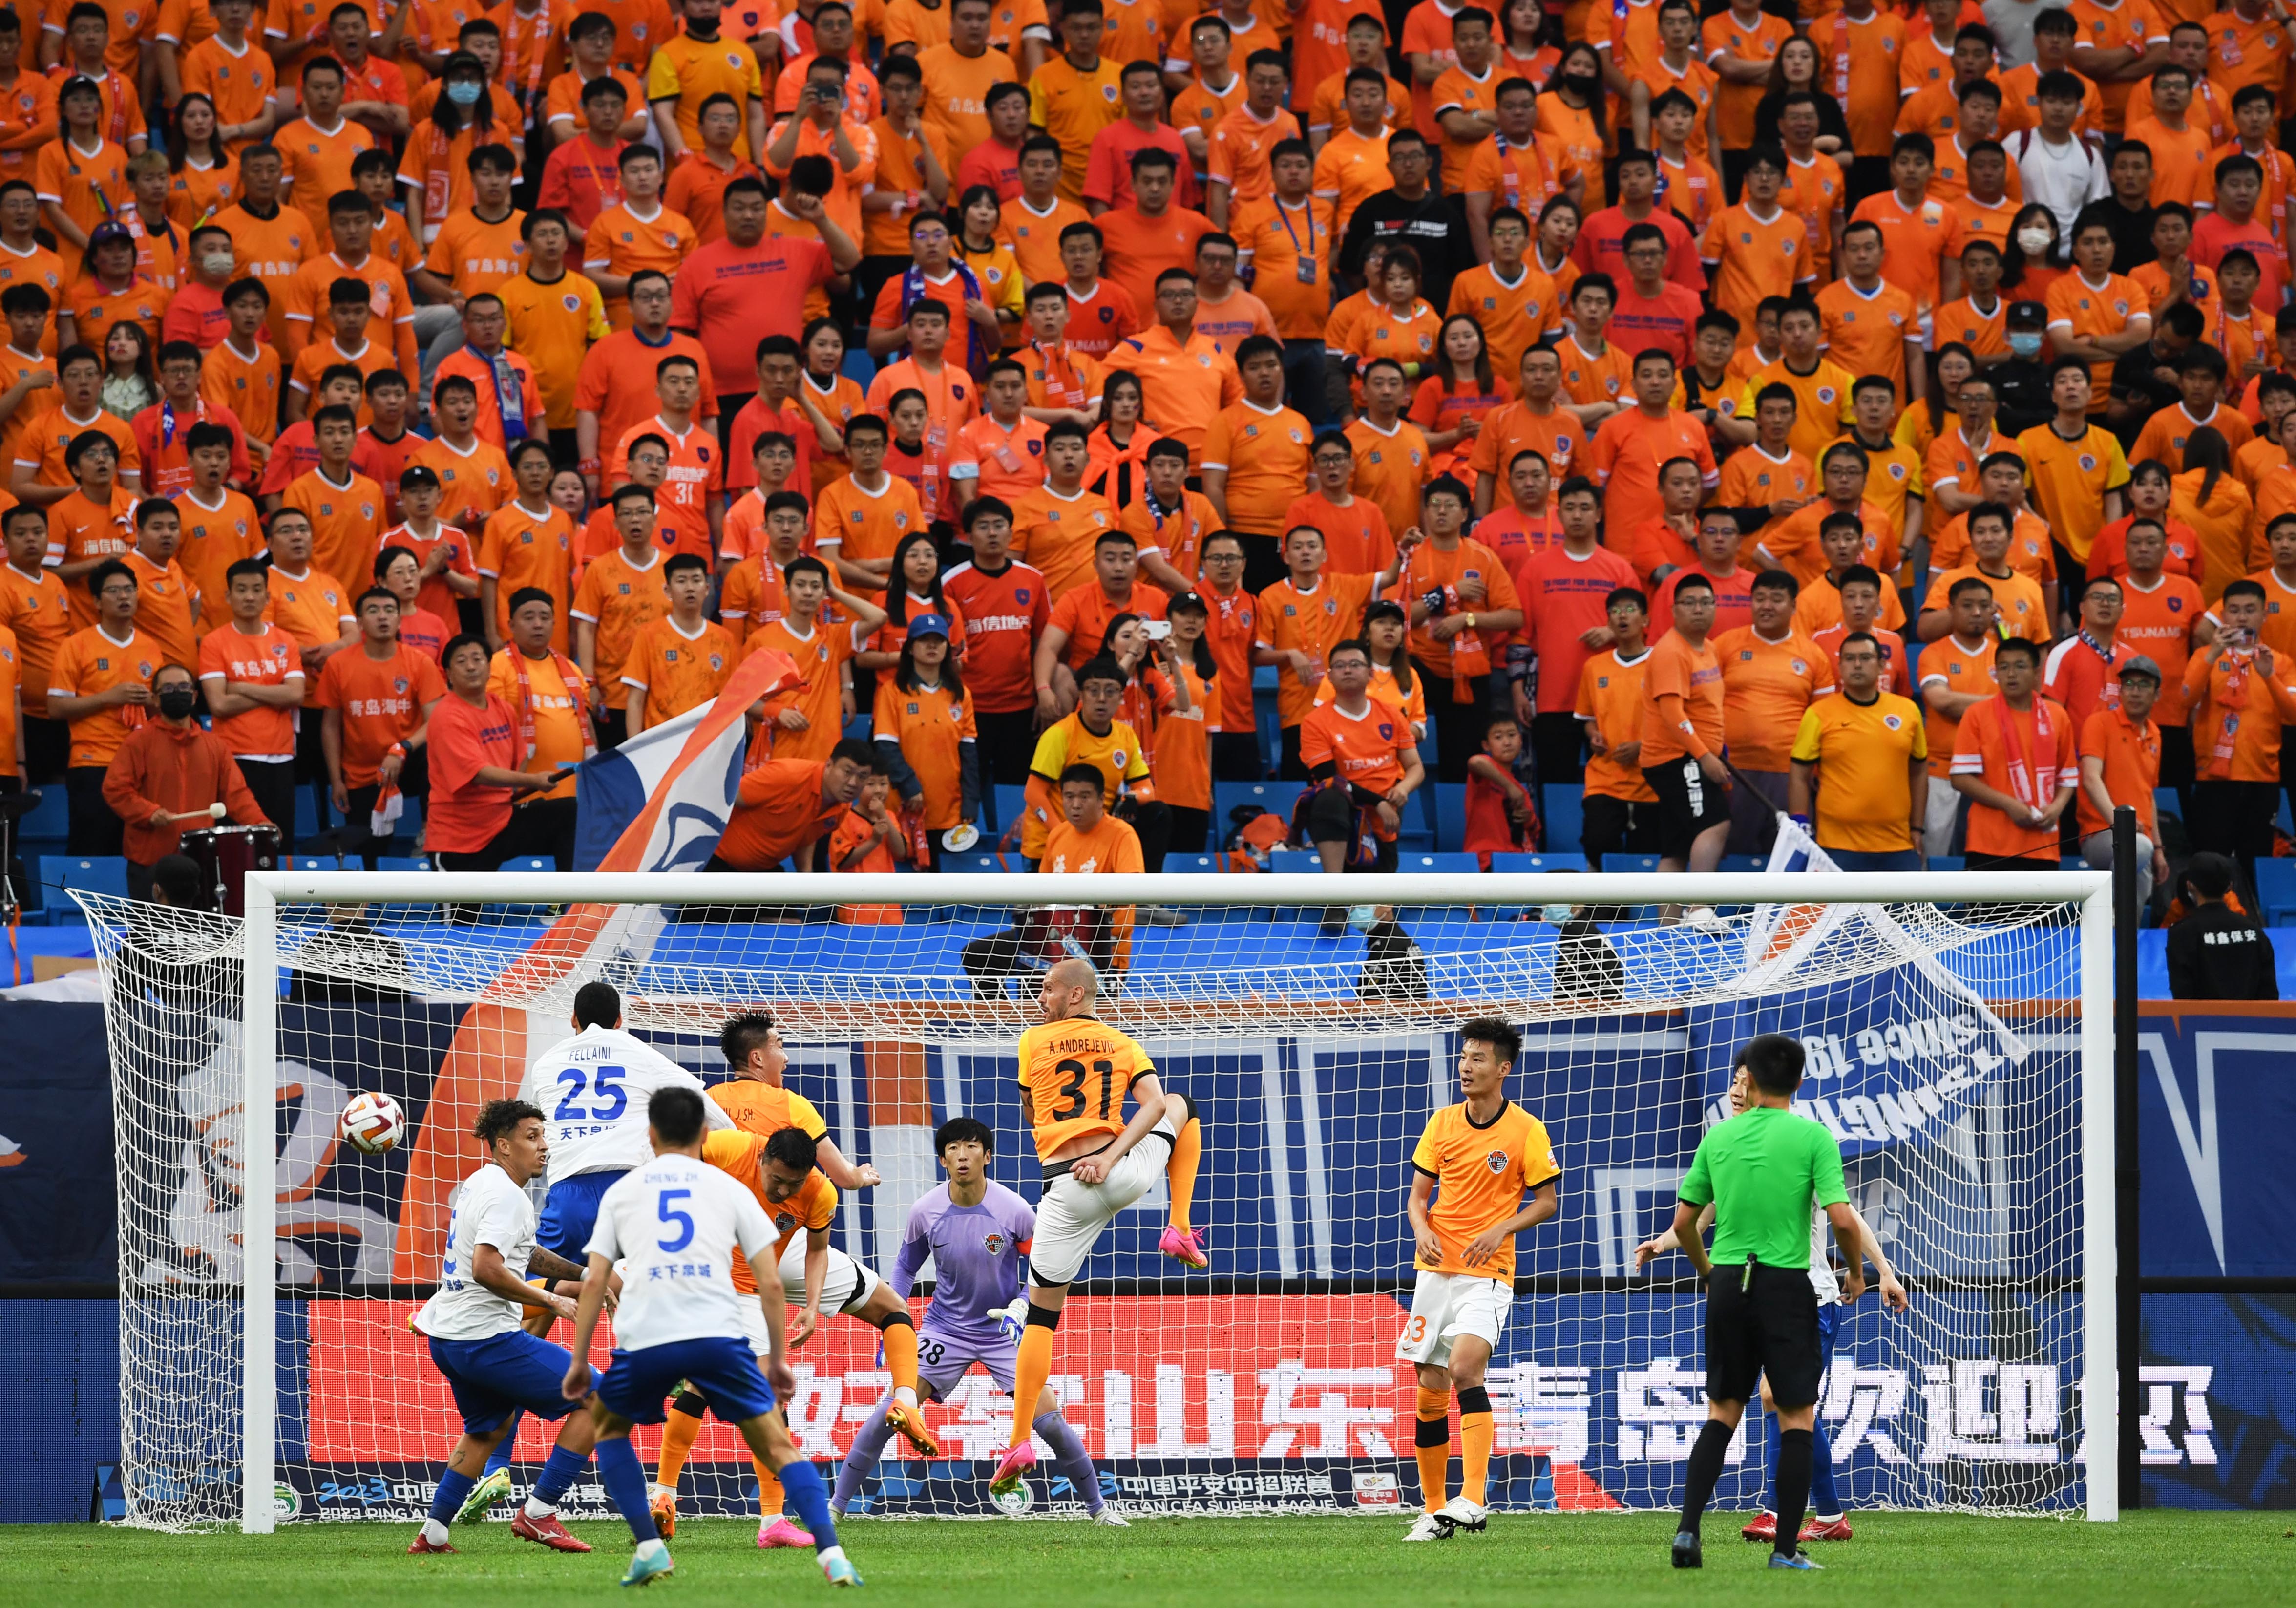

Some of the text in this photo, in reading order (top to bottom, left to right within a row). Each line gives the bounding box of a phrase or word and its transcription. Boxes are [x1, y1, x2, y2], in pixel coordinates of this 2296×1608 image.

[675, 482, 694, 505] 31
[349, 698, 411, 718] 青岛海牛
[569, 1046, 611, 1061] FELLAINI
[554, 1066, 628, 1121] 25
[1053, 1059, 1113, 1122] 31
[657, 1189, 694, 1253] 5
[917, 1339, 945, 1365] 28
[1123, 1475, 1332, 1495] 中国平安中超联赛
